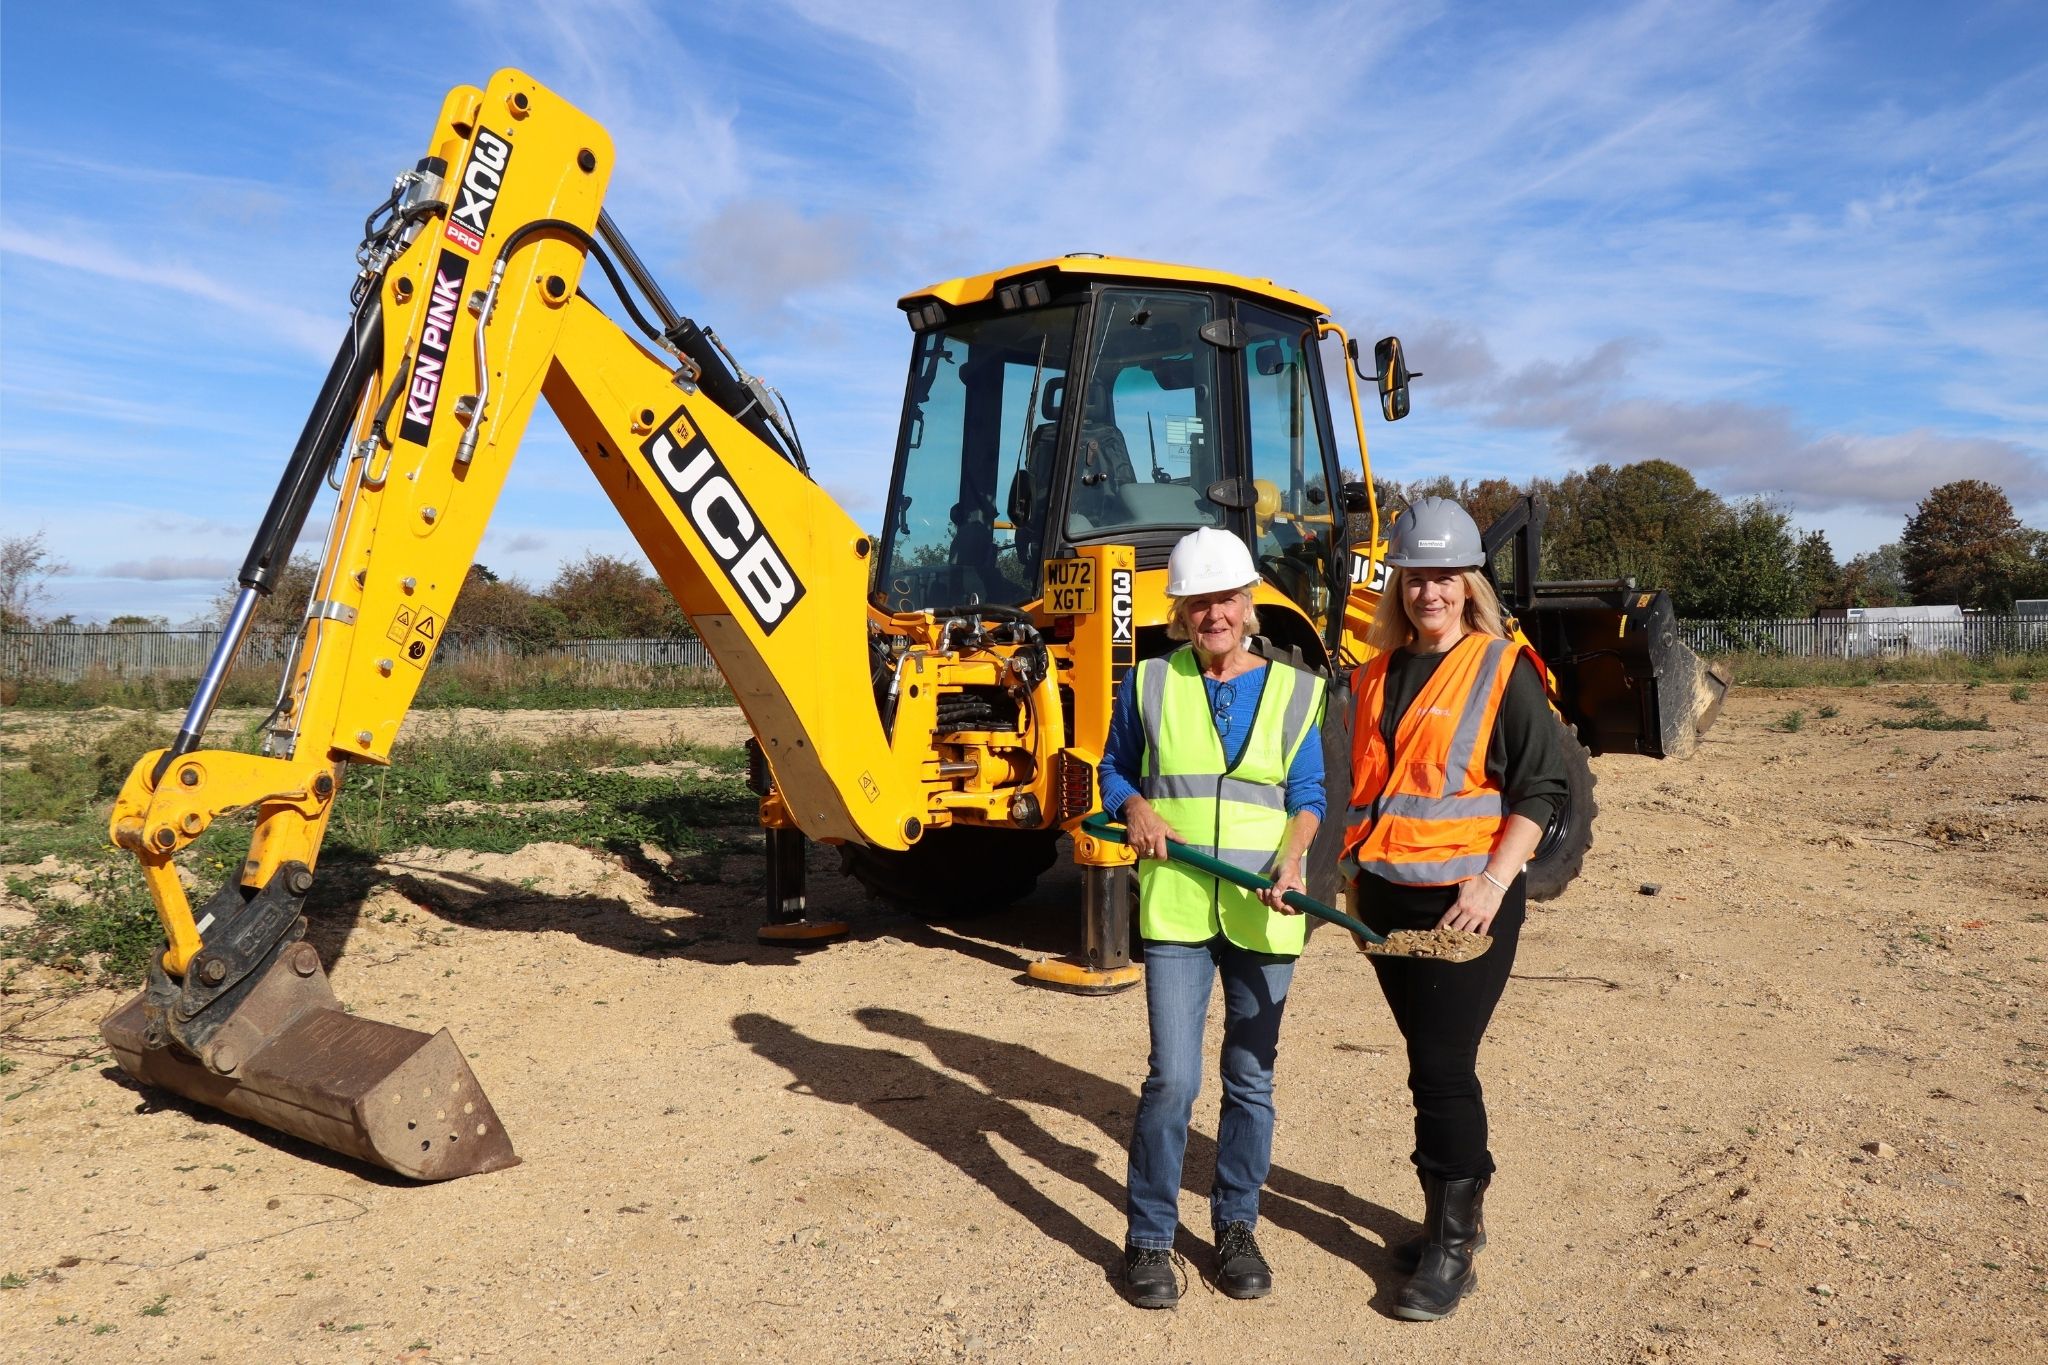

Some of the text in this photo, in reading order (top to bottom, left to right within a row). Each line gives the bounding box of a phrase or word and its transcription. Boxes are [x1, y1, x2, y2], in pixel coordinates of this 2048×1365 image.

[453, 132, 508, 231] 3CX
[447, 225, 481, 251] PRO
[406, 269, 463, 426] KEN PINK
[652, 434, 796, 623] JCB
[1048, 562, 1091, 585] WU72
[1053, 588, 1085, 610] XGT
[1112, 571, 1132, 639] 3CX
